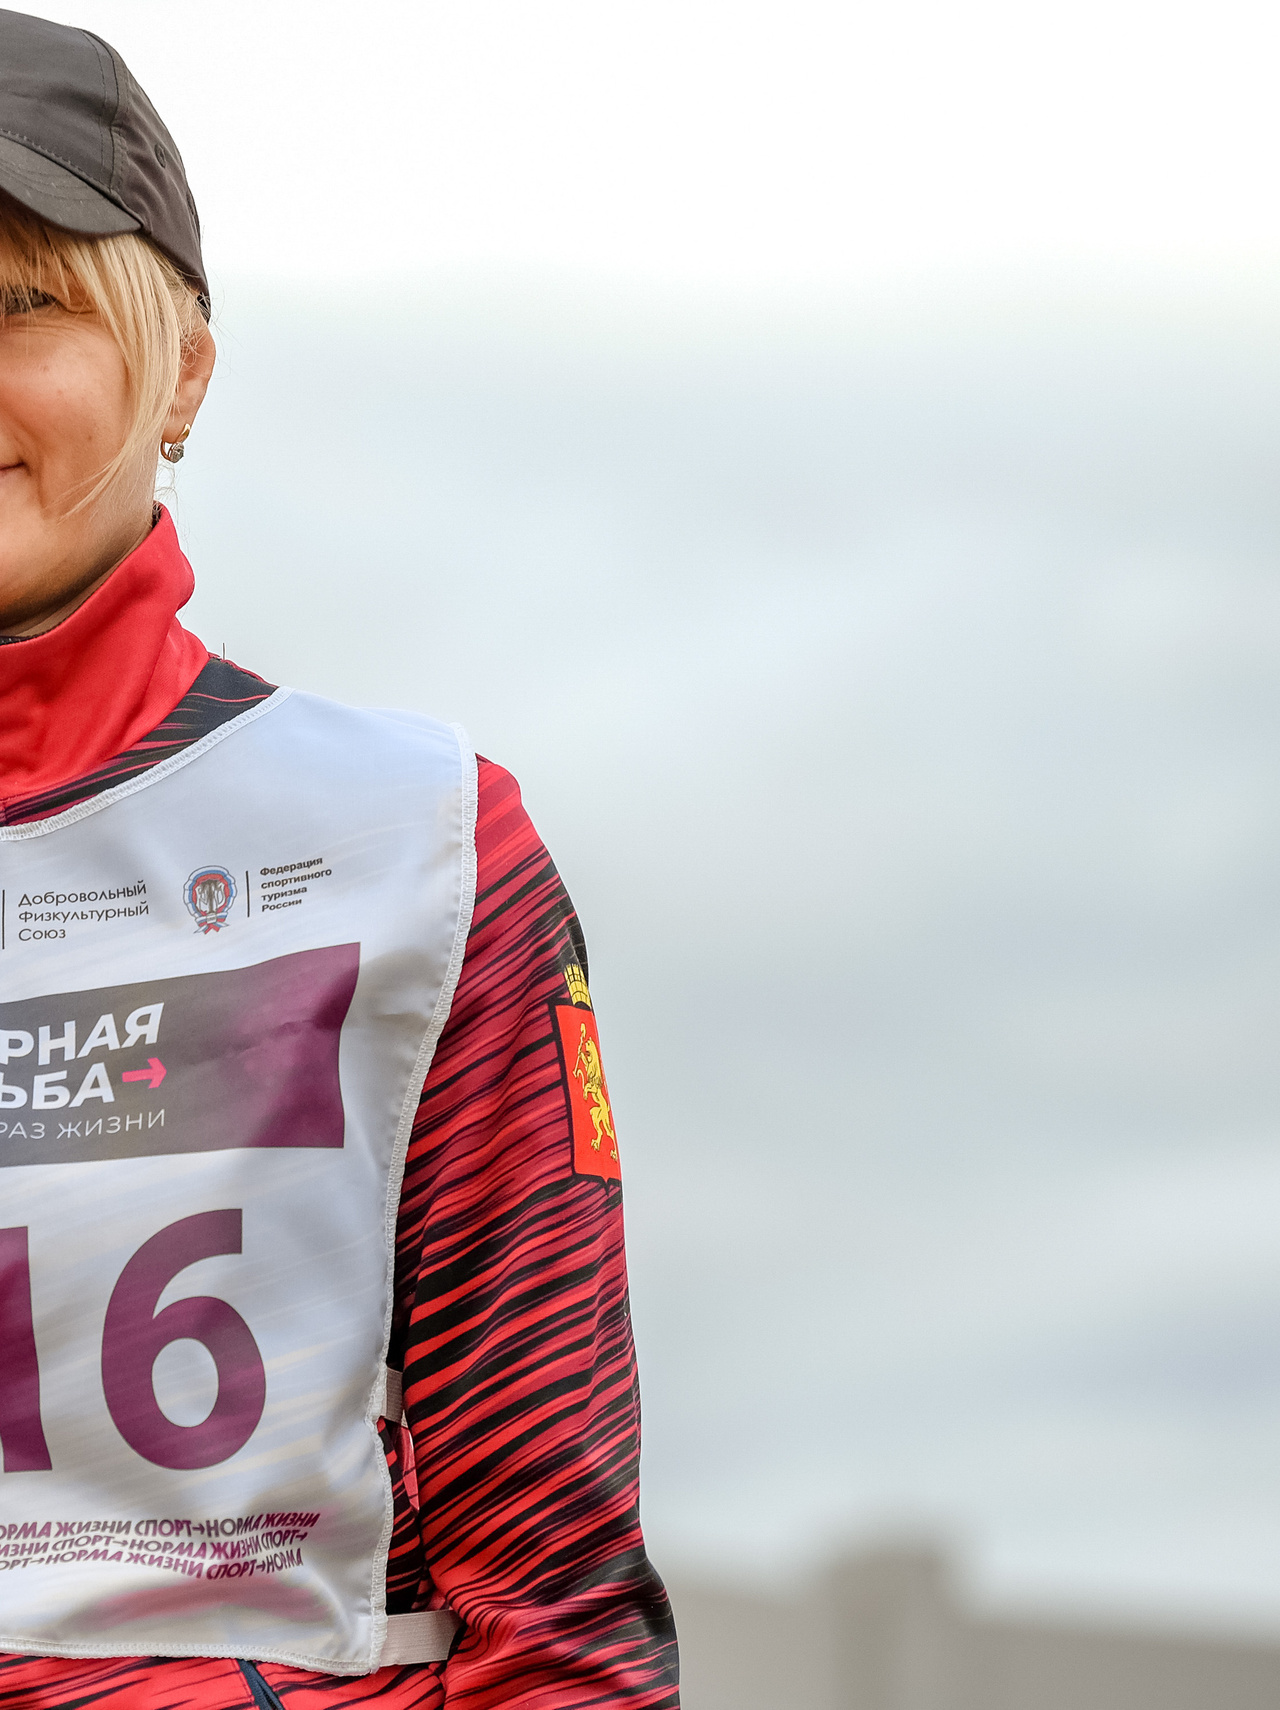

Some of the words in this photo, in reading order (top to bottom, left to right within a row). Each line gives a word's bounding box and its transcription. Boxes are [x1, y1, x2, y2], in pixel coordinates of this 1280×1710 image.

[260, 857, 323, 876] Федерация
[261, 868, 332, 889] спортивного
[18, 879, 147, 907] Добровольный
[261, 886, 308, 902] туризма
[18, 901, 149, 924] Физкультурный
[261, 898, 302, 912] России
[18, 928, 66, 941] Союз
[56, 1108, 166, 1139] ЖИЗНИ
[54, 1519, 132, 1538] ЖИЗНИ
[262, 1512, 321, 1530] ЖИЗНИ
[209, 1539, 262, 1560] ЖИЗНИ
[124, 1552, 204, 1580] ЖИЗНИ
